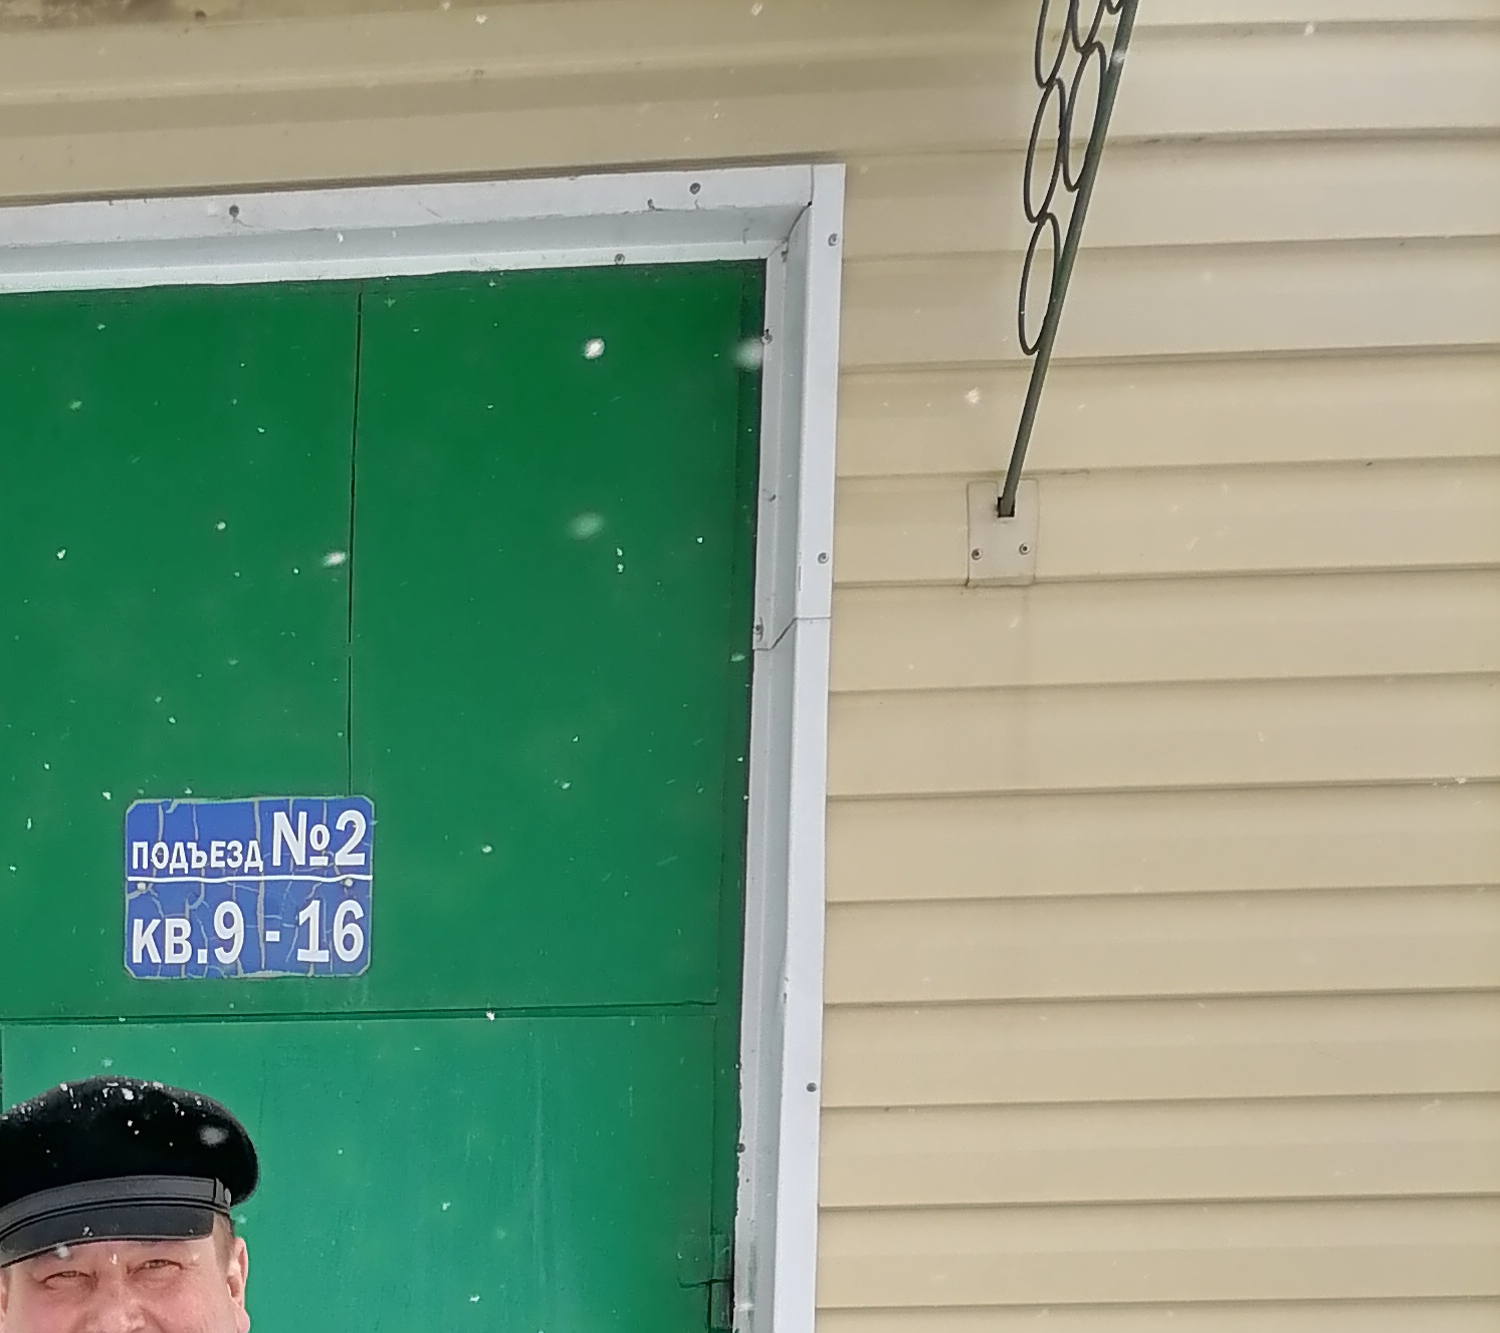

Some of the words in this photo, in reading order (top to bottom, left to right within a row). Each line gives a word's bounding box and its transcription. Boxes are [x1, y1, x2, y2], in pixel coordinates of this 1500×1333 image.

[132, 840, 263, 874] ПОДЪЕЗД
[272, 809, 367, 867] №2
[297, 899, 364, 963] 16
